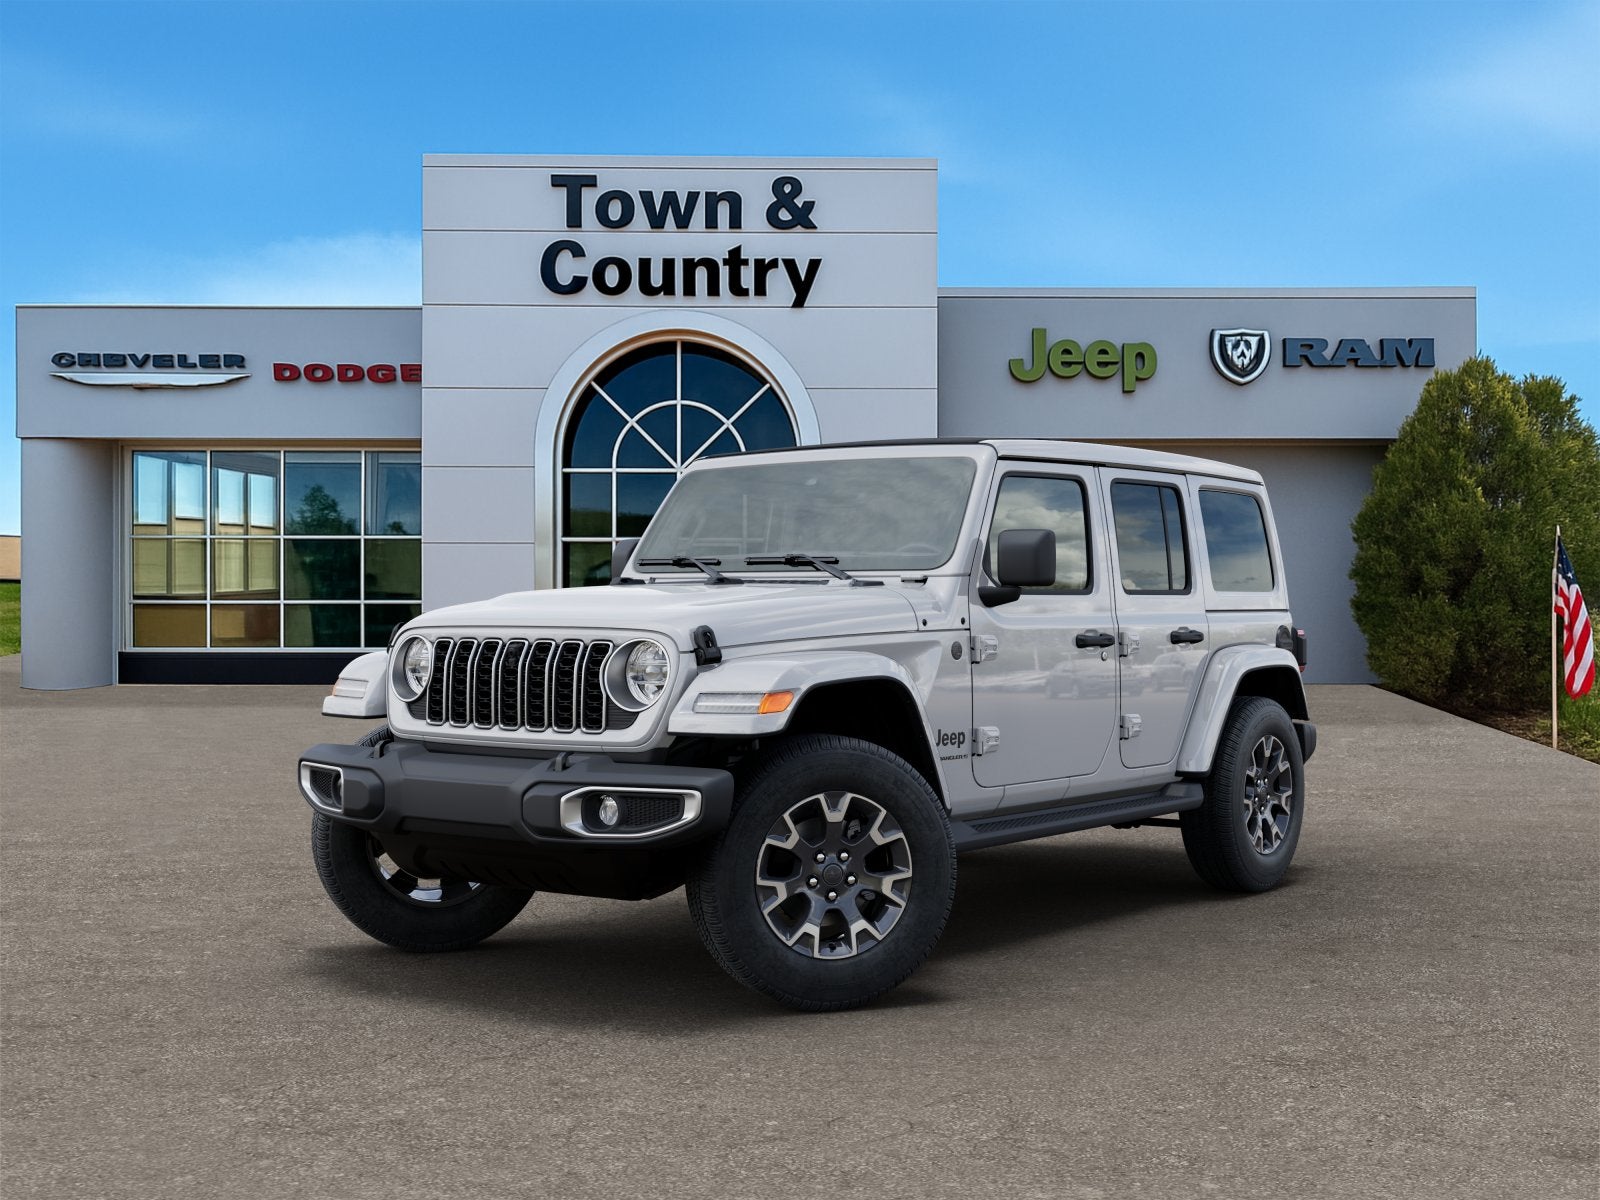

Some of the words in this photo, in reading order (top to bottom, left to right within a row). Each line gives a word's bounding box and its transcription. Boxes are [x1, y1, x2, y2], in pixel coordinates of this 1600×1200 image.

[550, 174, 743, 230] Town
[765, 175, 818, 230] &
[540, 239, 822, 308] Country
[273, 363, 422, 383] DODGE
[1009, 328, 1157, 392] Jeep
[1282, 337, 1436, 368] RAM
[936, 728, 966, 748] Jeep
